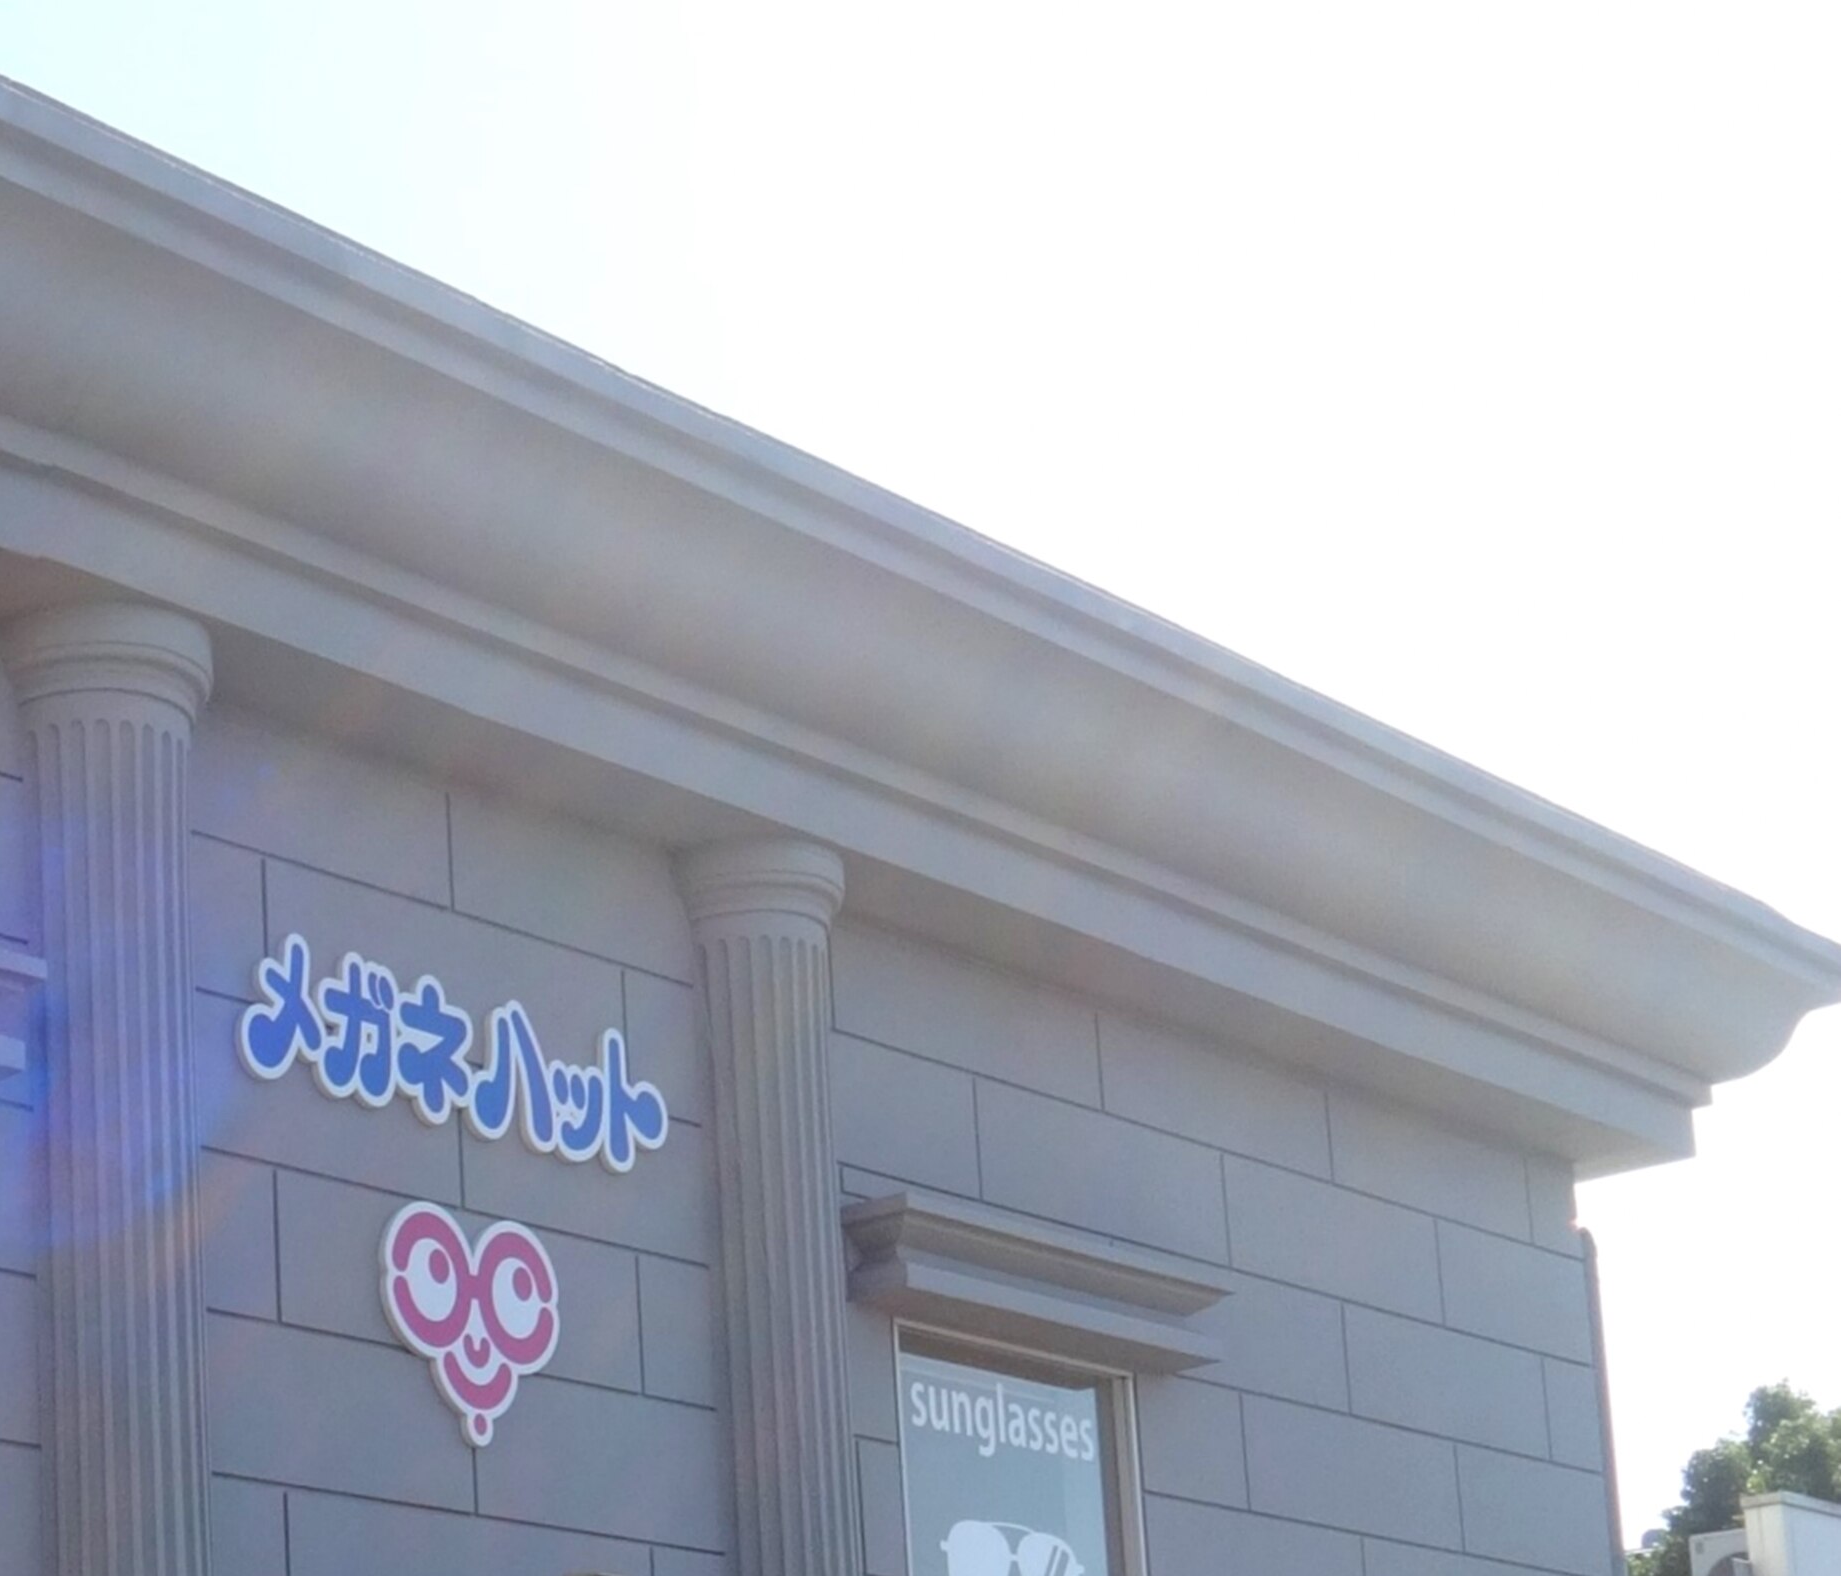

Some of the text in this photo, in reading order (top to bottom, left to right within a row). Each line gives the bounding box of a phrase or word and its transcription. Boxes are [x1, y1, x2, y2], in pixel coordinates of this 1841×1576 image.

[241, 936, 666, 1170] メガネハット
[910, 1382, 1095, 1462] sunglasses
